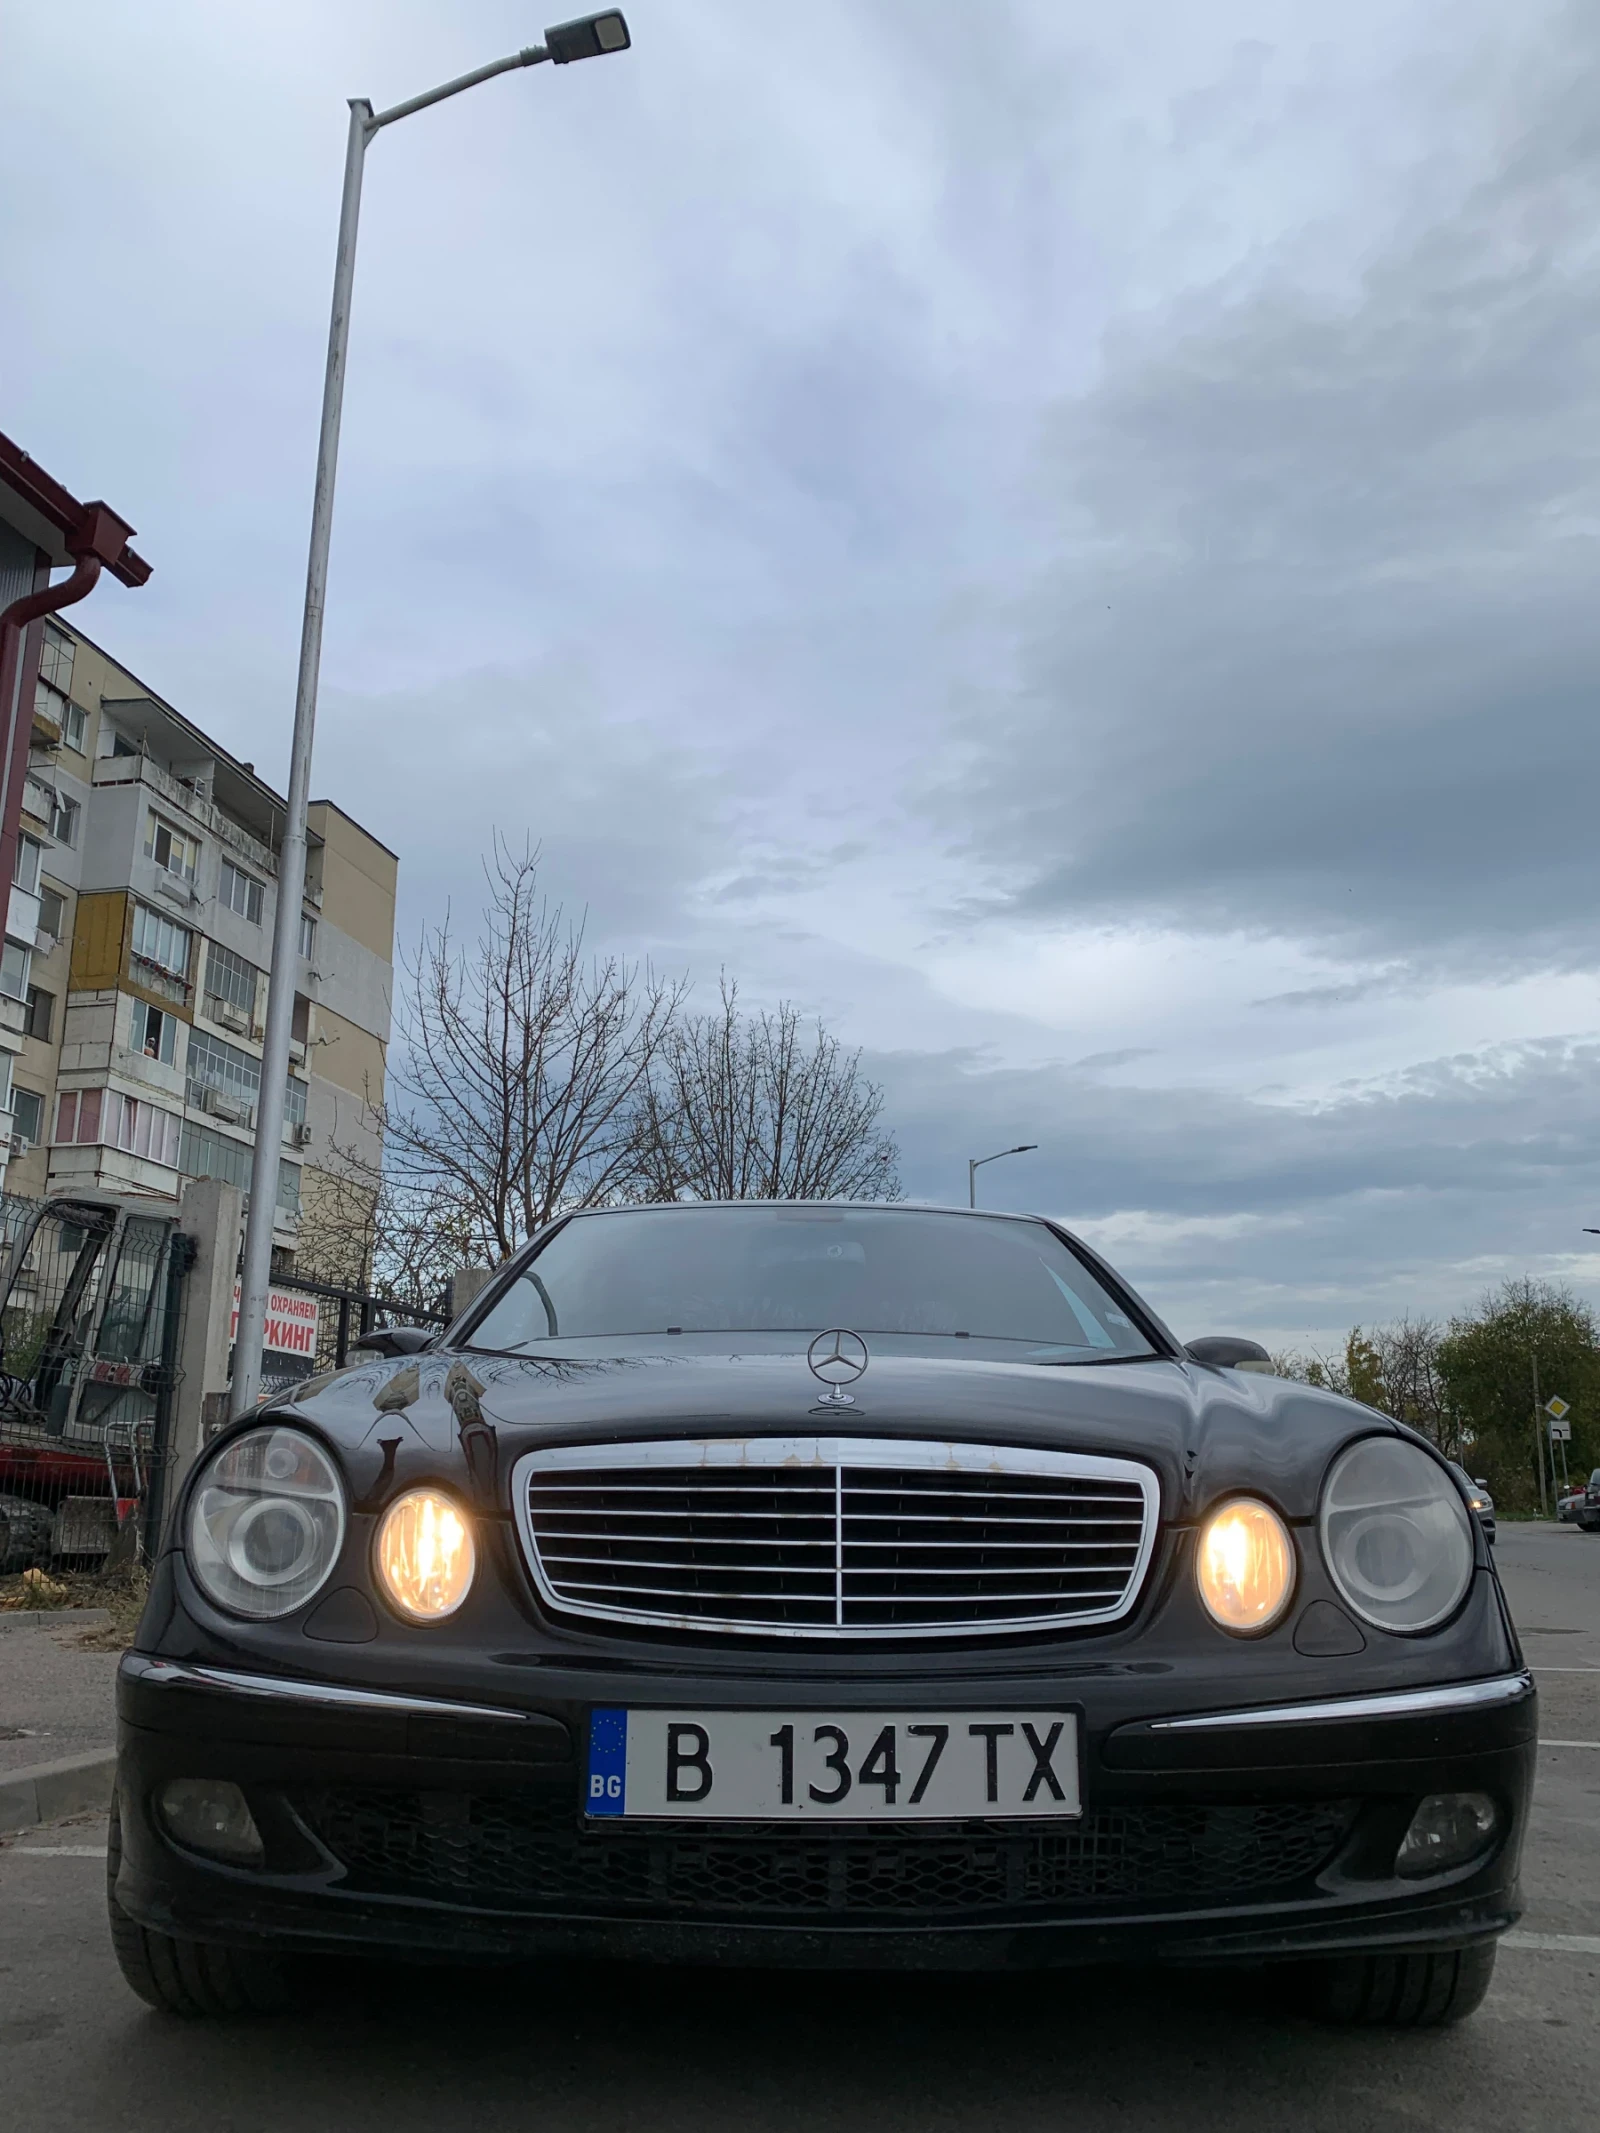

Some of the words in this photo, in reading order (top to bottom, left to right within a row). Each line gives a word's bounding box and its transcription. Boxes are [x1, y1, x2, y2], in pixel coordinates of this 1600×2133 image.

[271, 1294, 317, 1320] ОХРАНЯЕМ
[230, 1311, 314, 1352] ПРКИНГ
[666, 1723, 713, 1803] B
[770, 1724, 949, 1804] 1347
[969, 1722, 1067, 1803] TX
[590, 1774, 621, 1798] BG
